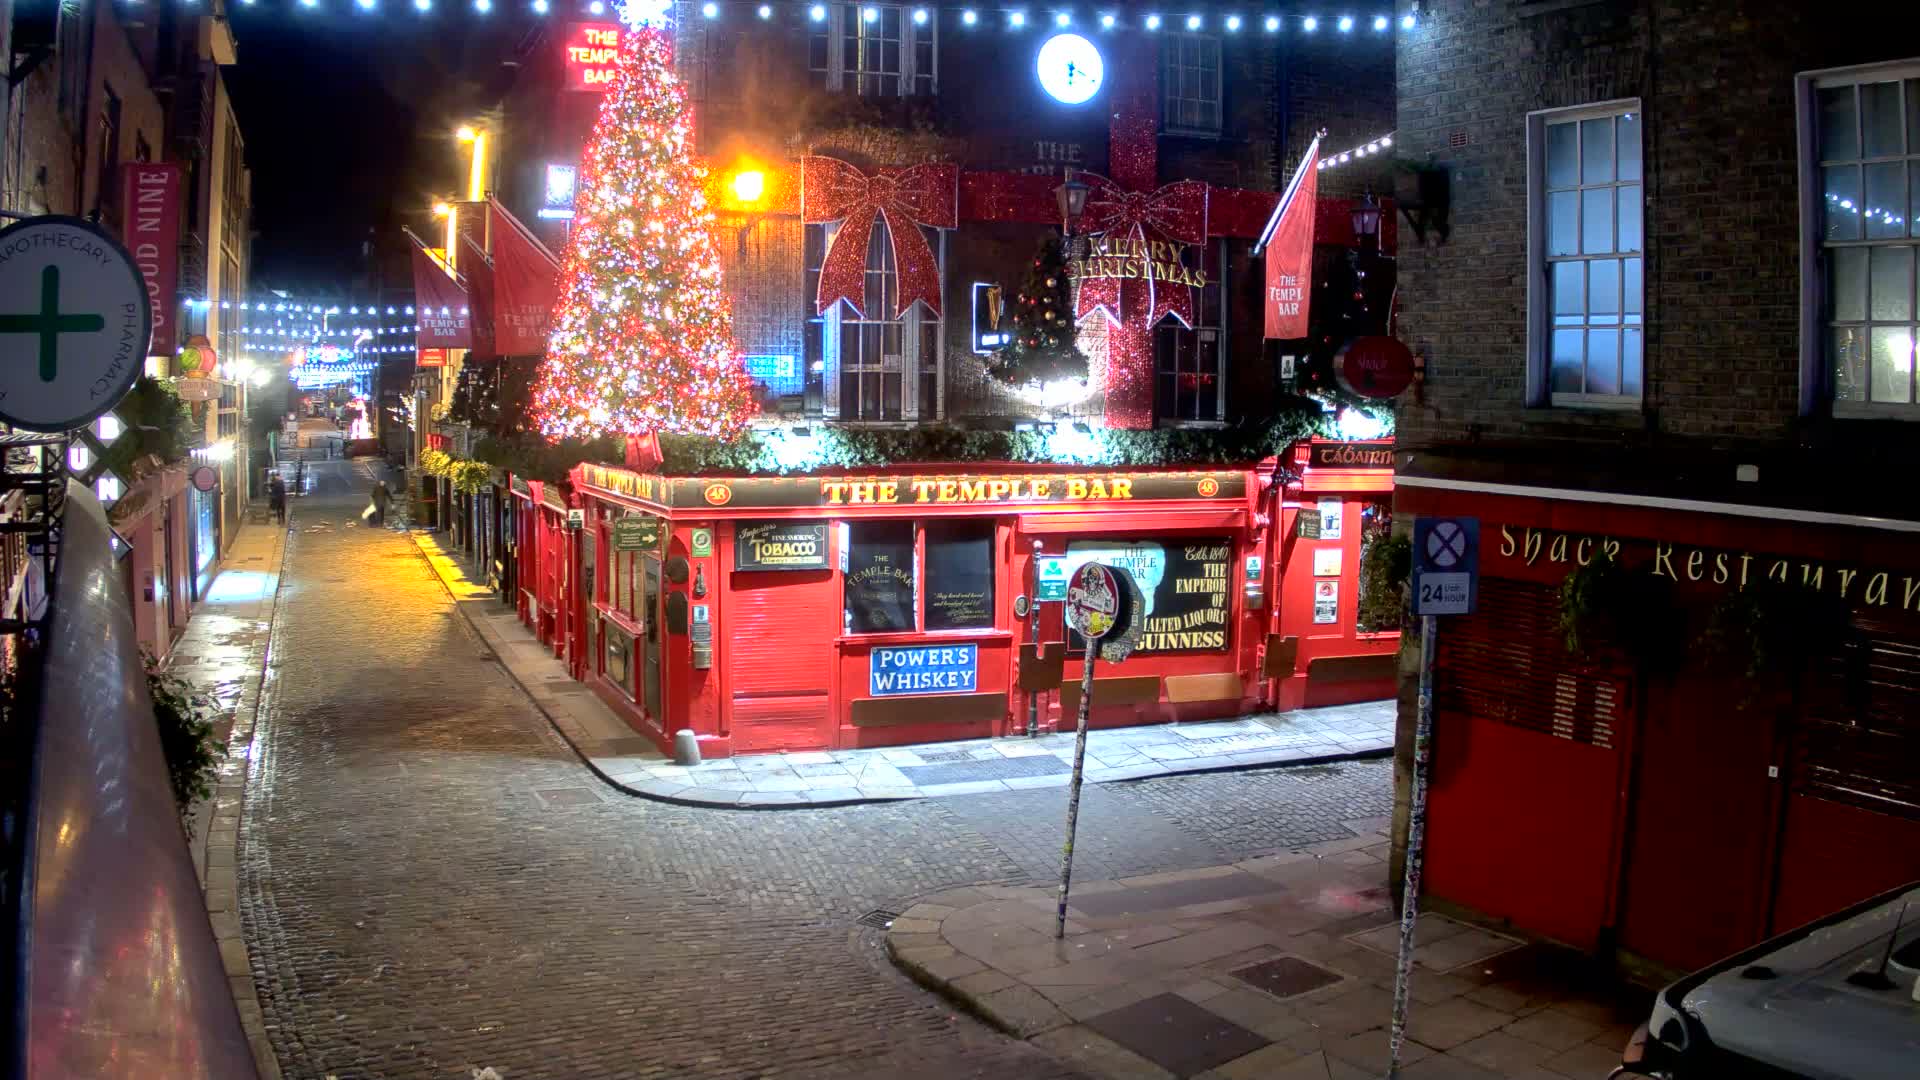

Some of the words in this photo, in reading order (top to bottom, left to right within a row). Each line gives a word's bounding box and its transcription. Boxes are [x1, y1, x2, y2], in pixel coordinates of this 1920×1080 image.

[584, 29, 618, 46] THE
[568, 46, 622, 64] TEMPL
[138, 172, 169, 232] NINE
[1088, 237, 1185, 262] MERRY
[1280, 275, 1296, 286] THE
[1270, 286, 1304, 302] TEMPL
[1279, 302, 1299, 316] BAR
[422, 318, 465, 329] TEMPLE
[433, 327, 457, 337] BAR
[89, 303, 137, 400] PHARMACY
[823, 481, 899, 504] THE
[912, 479, 1050, 504] TEMPLE
[1066, 478, 1133, 500] BAR
[748, 538, 817, 562] TOBACCO
[873, 554, 889, 562] THE
[1124, 546, 1146, 557] THE
[1111, 557, 1157, 568] TEMPLE
[1203, 563, 1227, 578] THE
[847, 566, 891, 587] TEMPLE
[1176, 578, 1226, 593] EMPEROR
[1422, 583, 1443, 603] 24
[1212, 593, 1226, 607] OF
[1183, 608, 1228, 629] LIQUORS
[880, 647, 969, 668] POWER'S
[874, 670, 974, 690] WHISKEY
